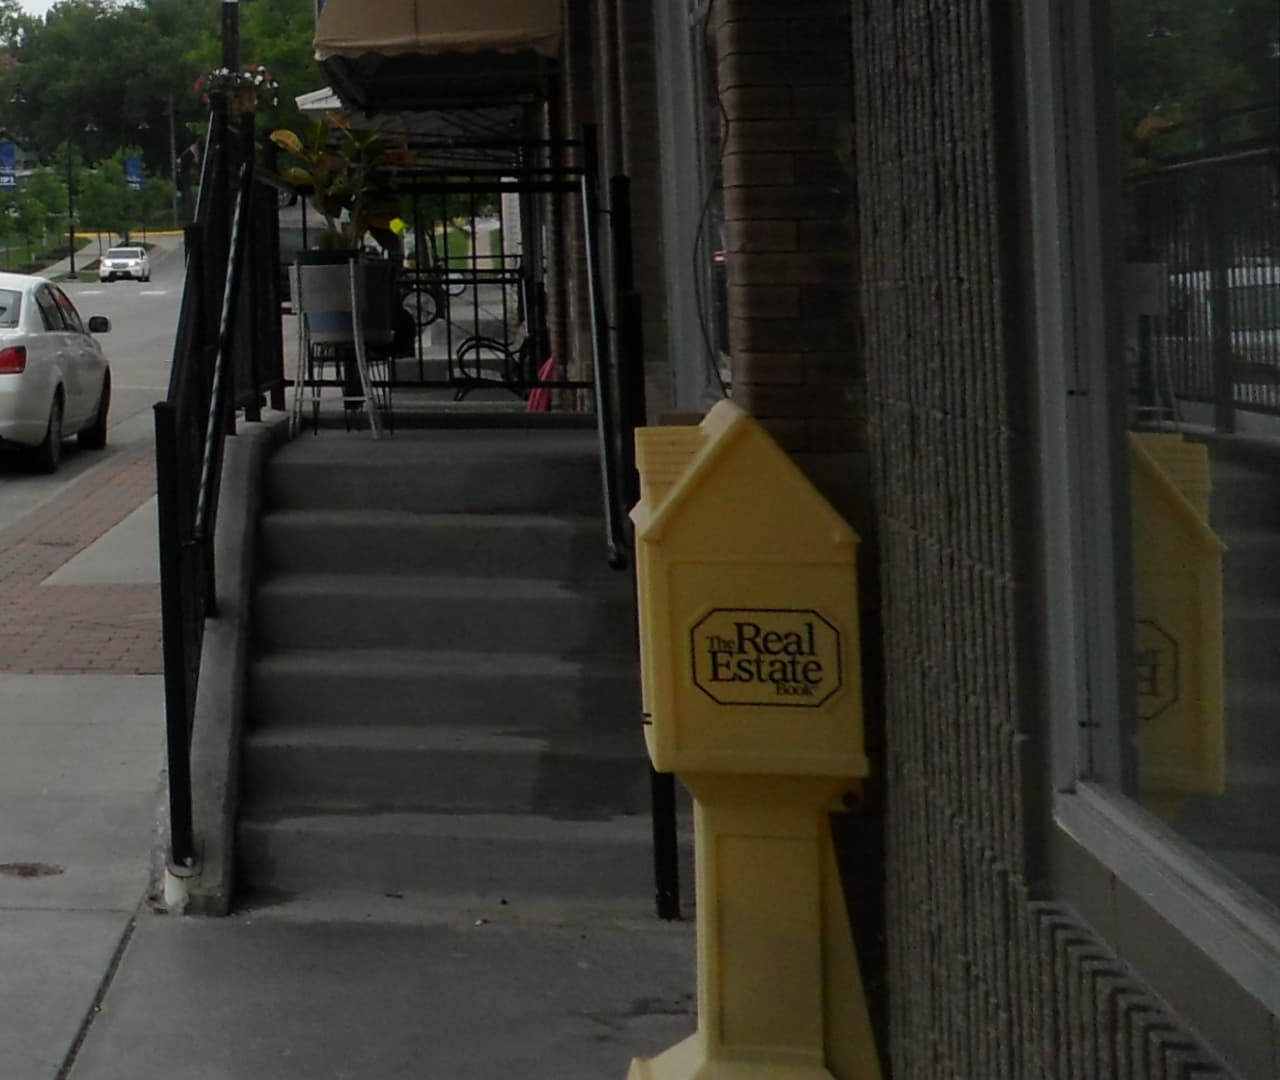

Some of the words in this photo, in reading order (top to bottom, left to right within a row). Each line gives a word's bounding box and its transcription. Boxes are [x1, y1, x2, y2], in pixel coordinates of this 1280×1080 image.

[705, 634, 736, 651] The
[733, 622, 817, 656] Real
[707, 649, 824, 685] Estate
[775, 681, 815, 696] Book
